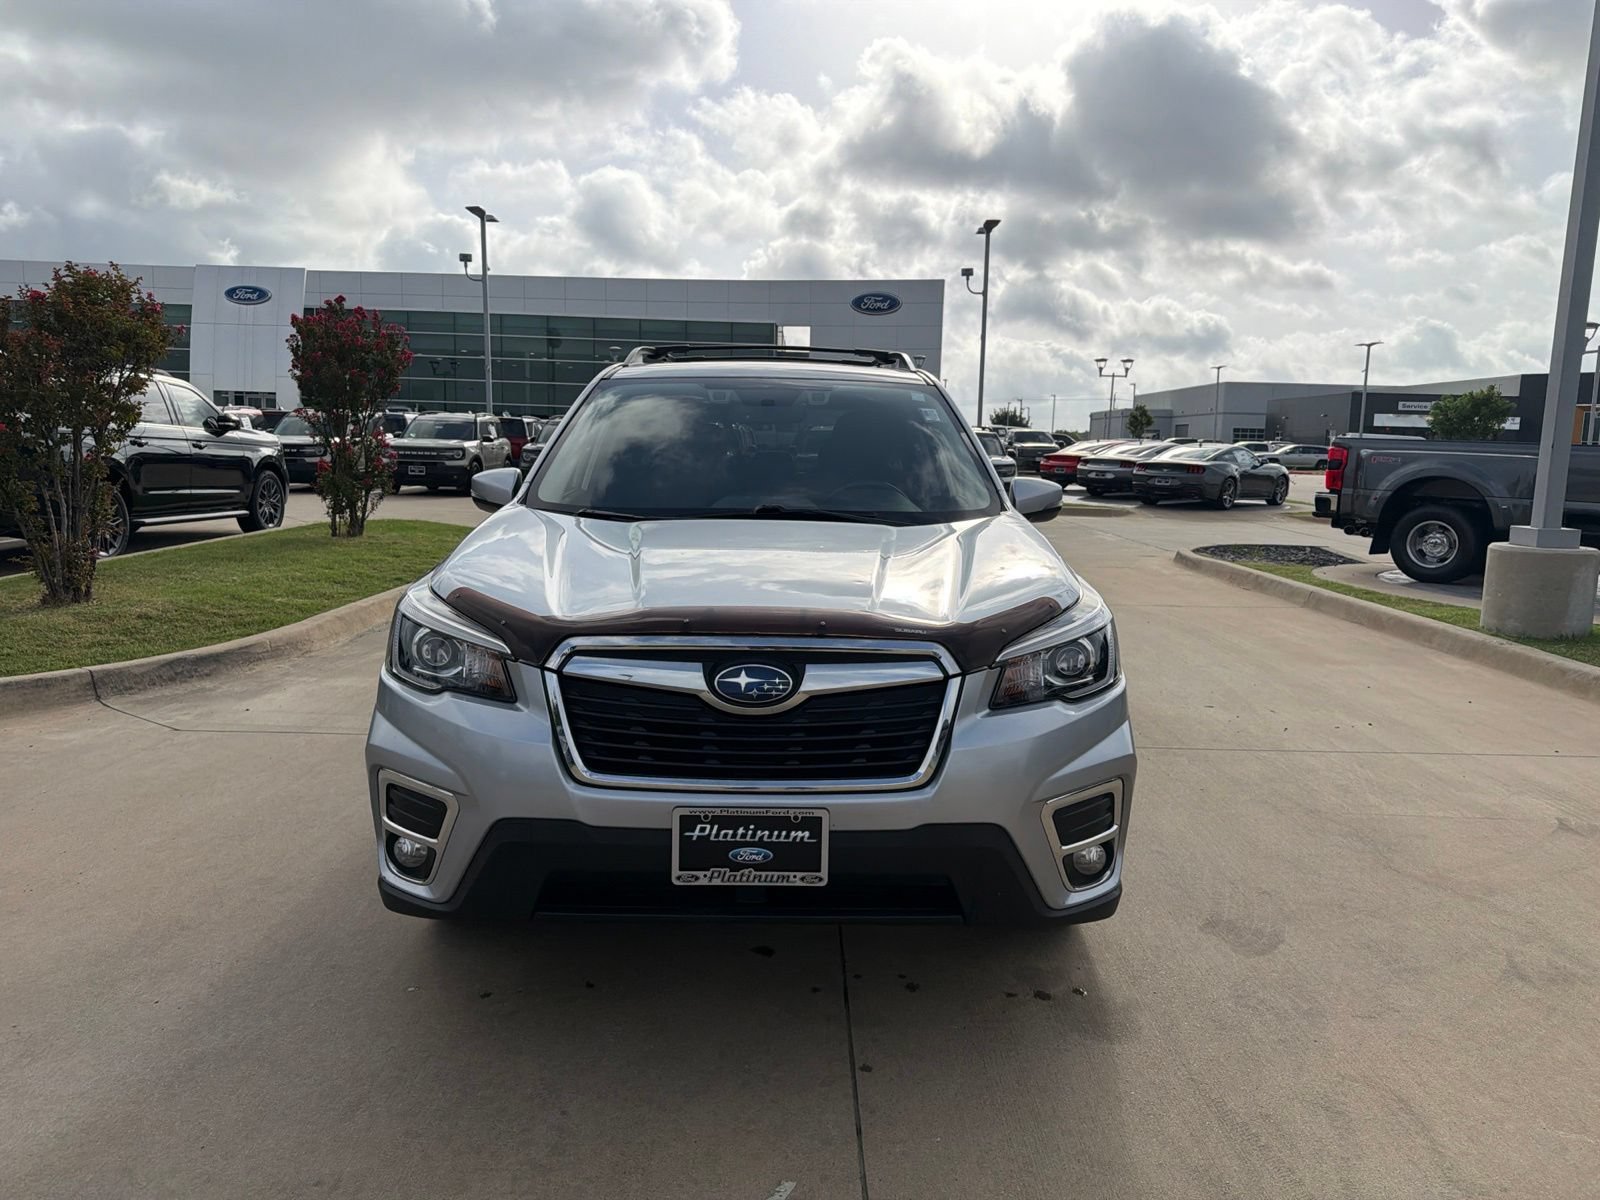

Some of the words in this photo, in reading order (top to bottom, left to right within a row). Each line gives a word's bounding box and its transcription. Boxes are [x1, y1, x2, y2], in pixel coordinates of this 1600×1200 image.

[233, 288, 259, 300] Ford
[861, 296, 890, 309] Ford
[684, 824, 817, 843] Platinum
[737, 850, 764, 861] Ford
[708, 869, 798, 884] Platinum
